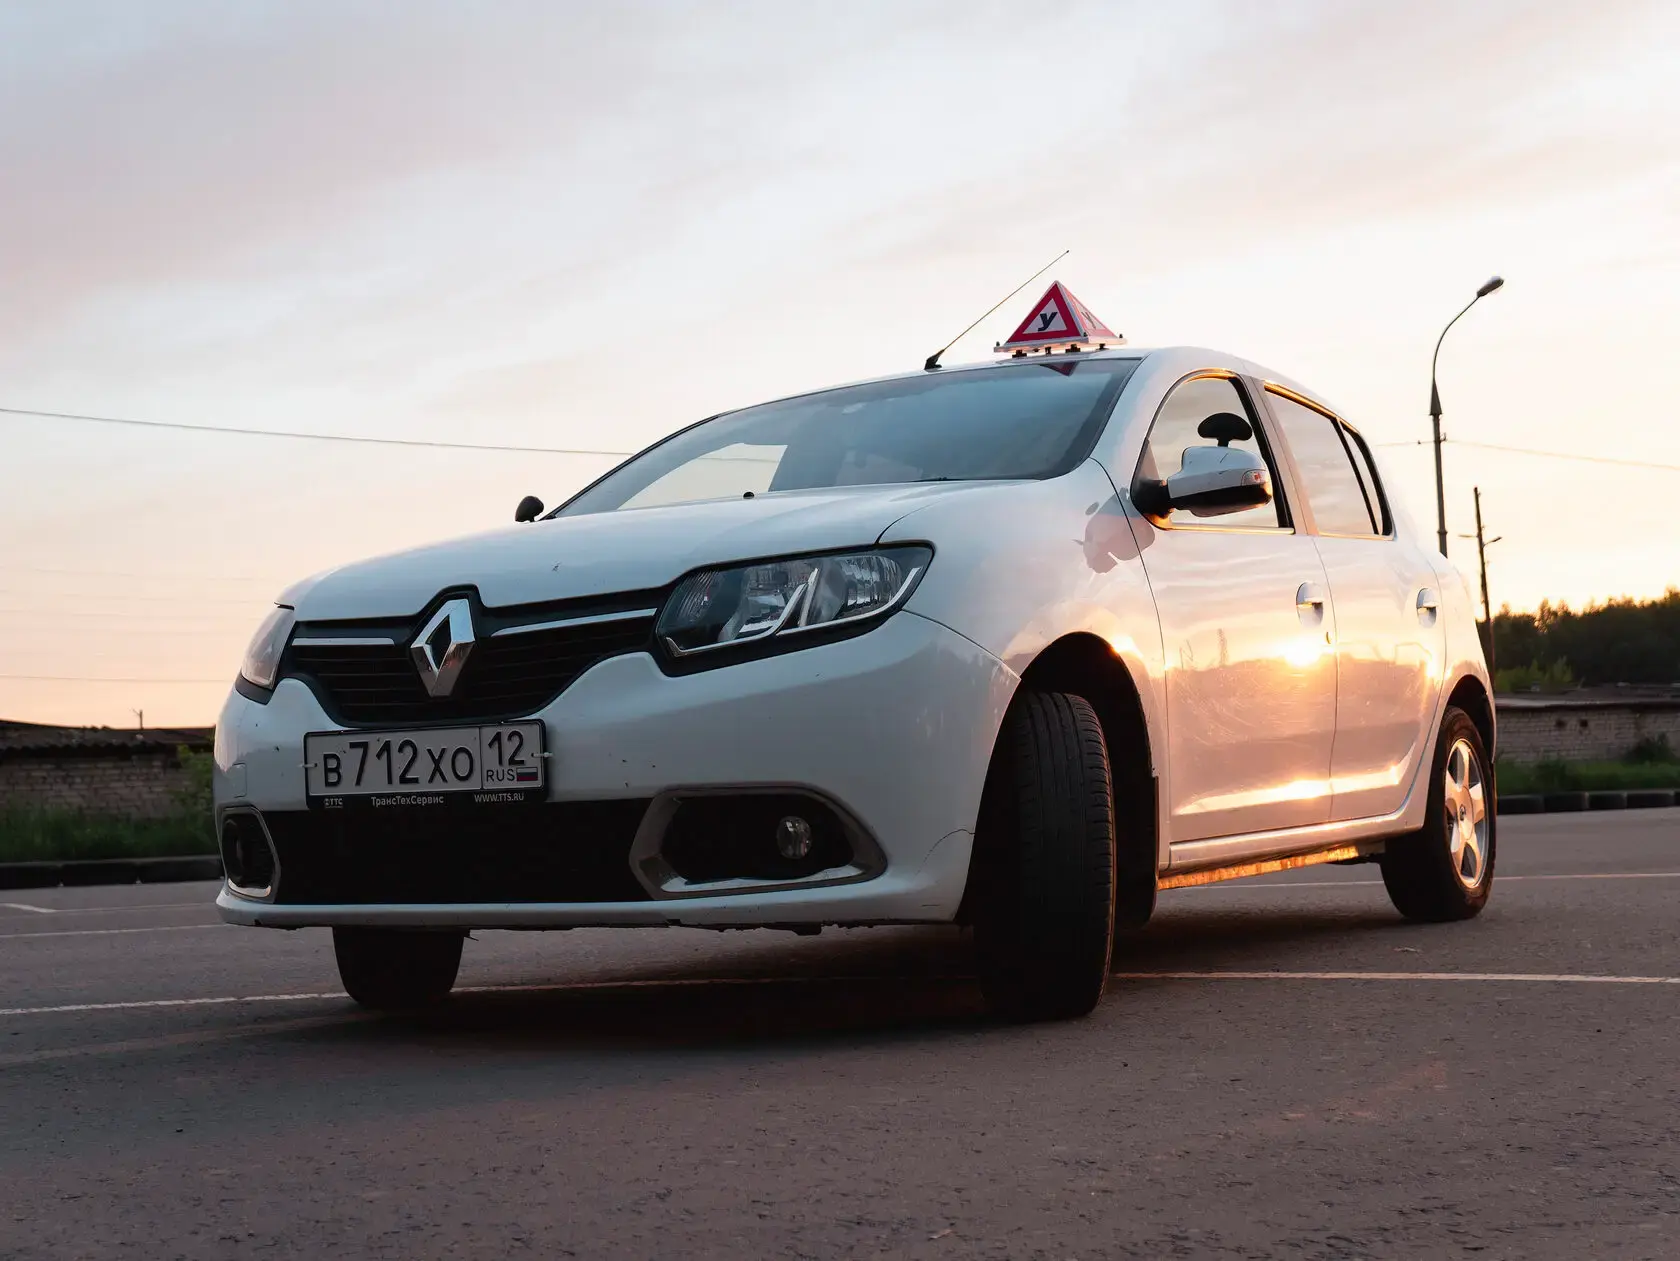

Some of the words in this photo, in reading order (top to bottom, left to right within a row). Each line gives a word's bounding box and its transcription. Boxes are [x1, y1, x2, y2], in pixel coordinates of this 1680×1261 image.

[487, 730, 525, 766] 12
[486, 769, 516, 782] RUS
[370, 796, 444, 807] ТрансТехСервис
[474, 793, 525, 803] WWW.TTS.RU
